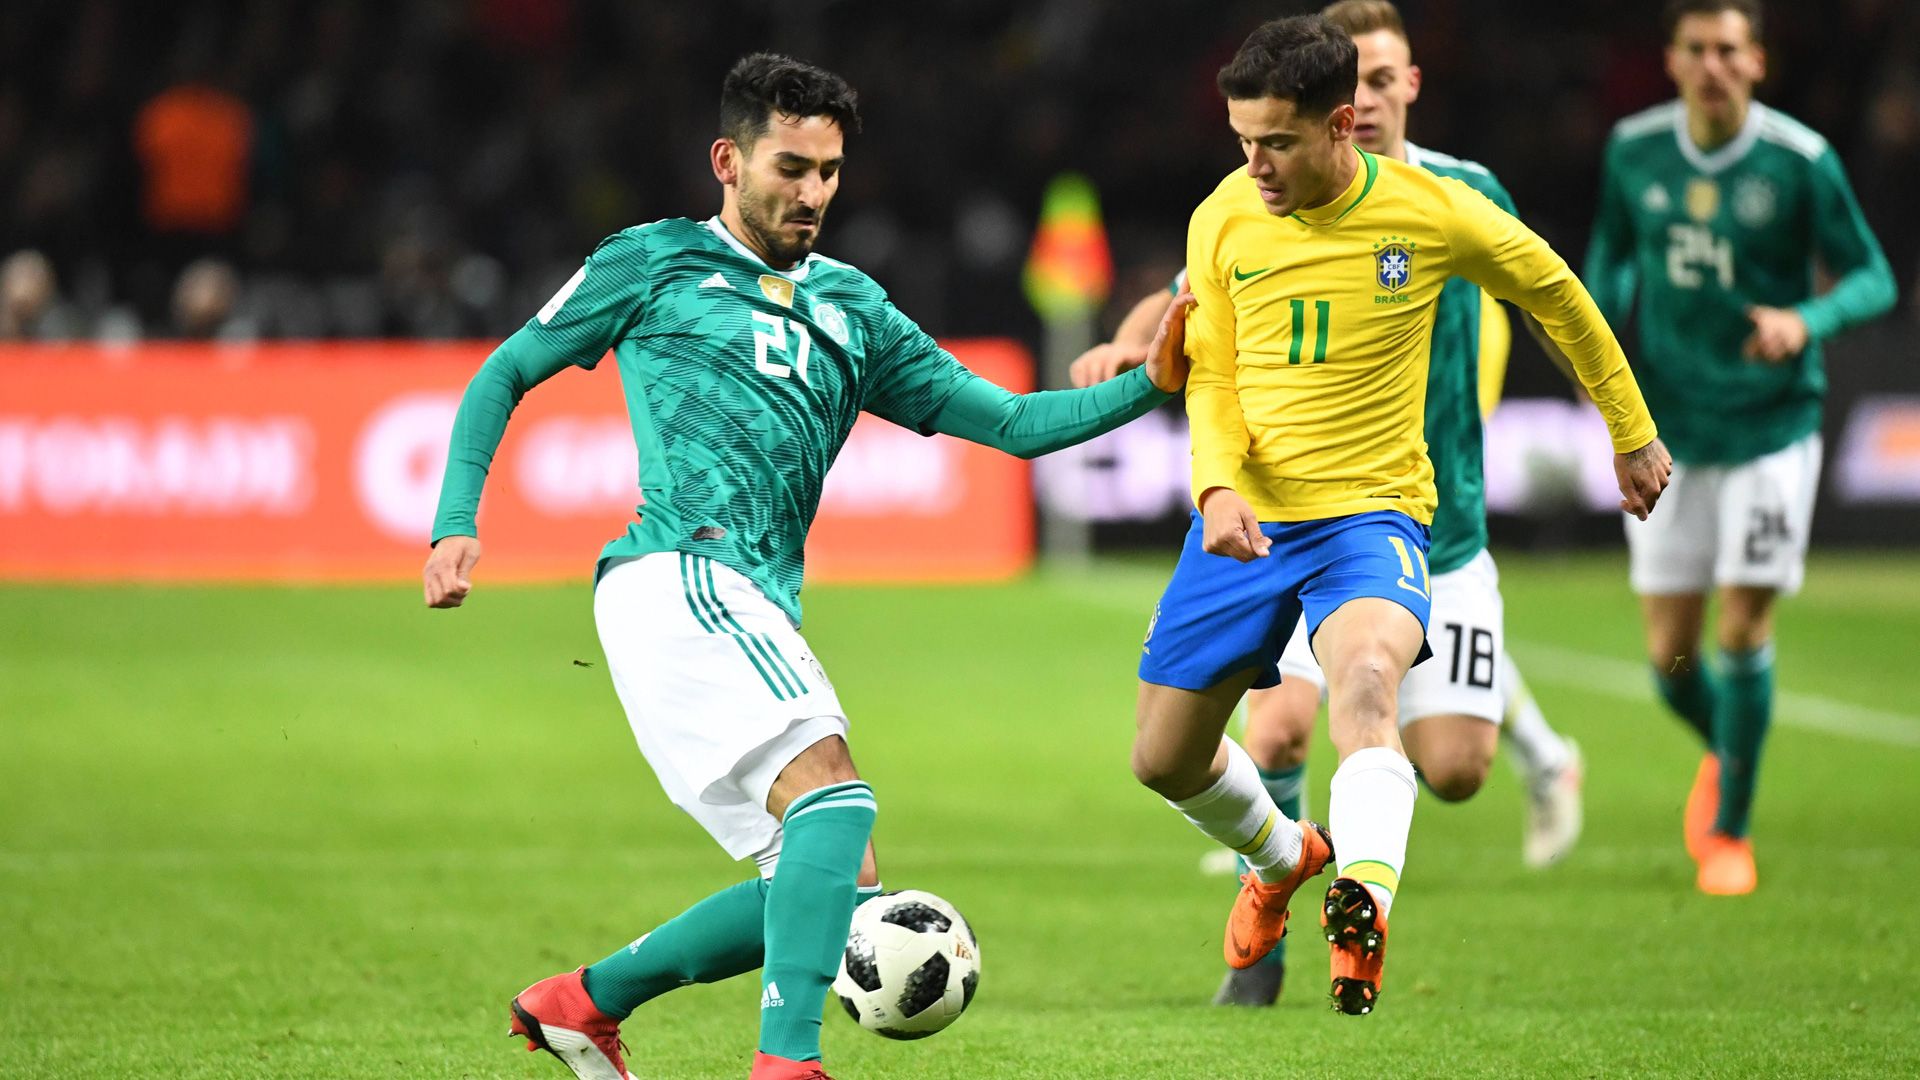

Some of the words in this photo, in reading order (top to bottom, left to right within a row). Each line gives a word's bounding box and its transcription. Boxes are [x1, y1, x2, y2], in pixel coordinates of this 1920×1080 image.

[1666, 222, 1734, 290] 24
[751, 309, 811, 388] 21
[1288, 298, 1330, 365] 11
[1388, 536, 1430, 598] 11
[1444, 621, 1494, 689] 18
